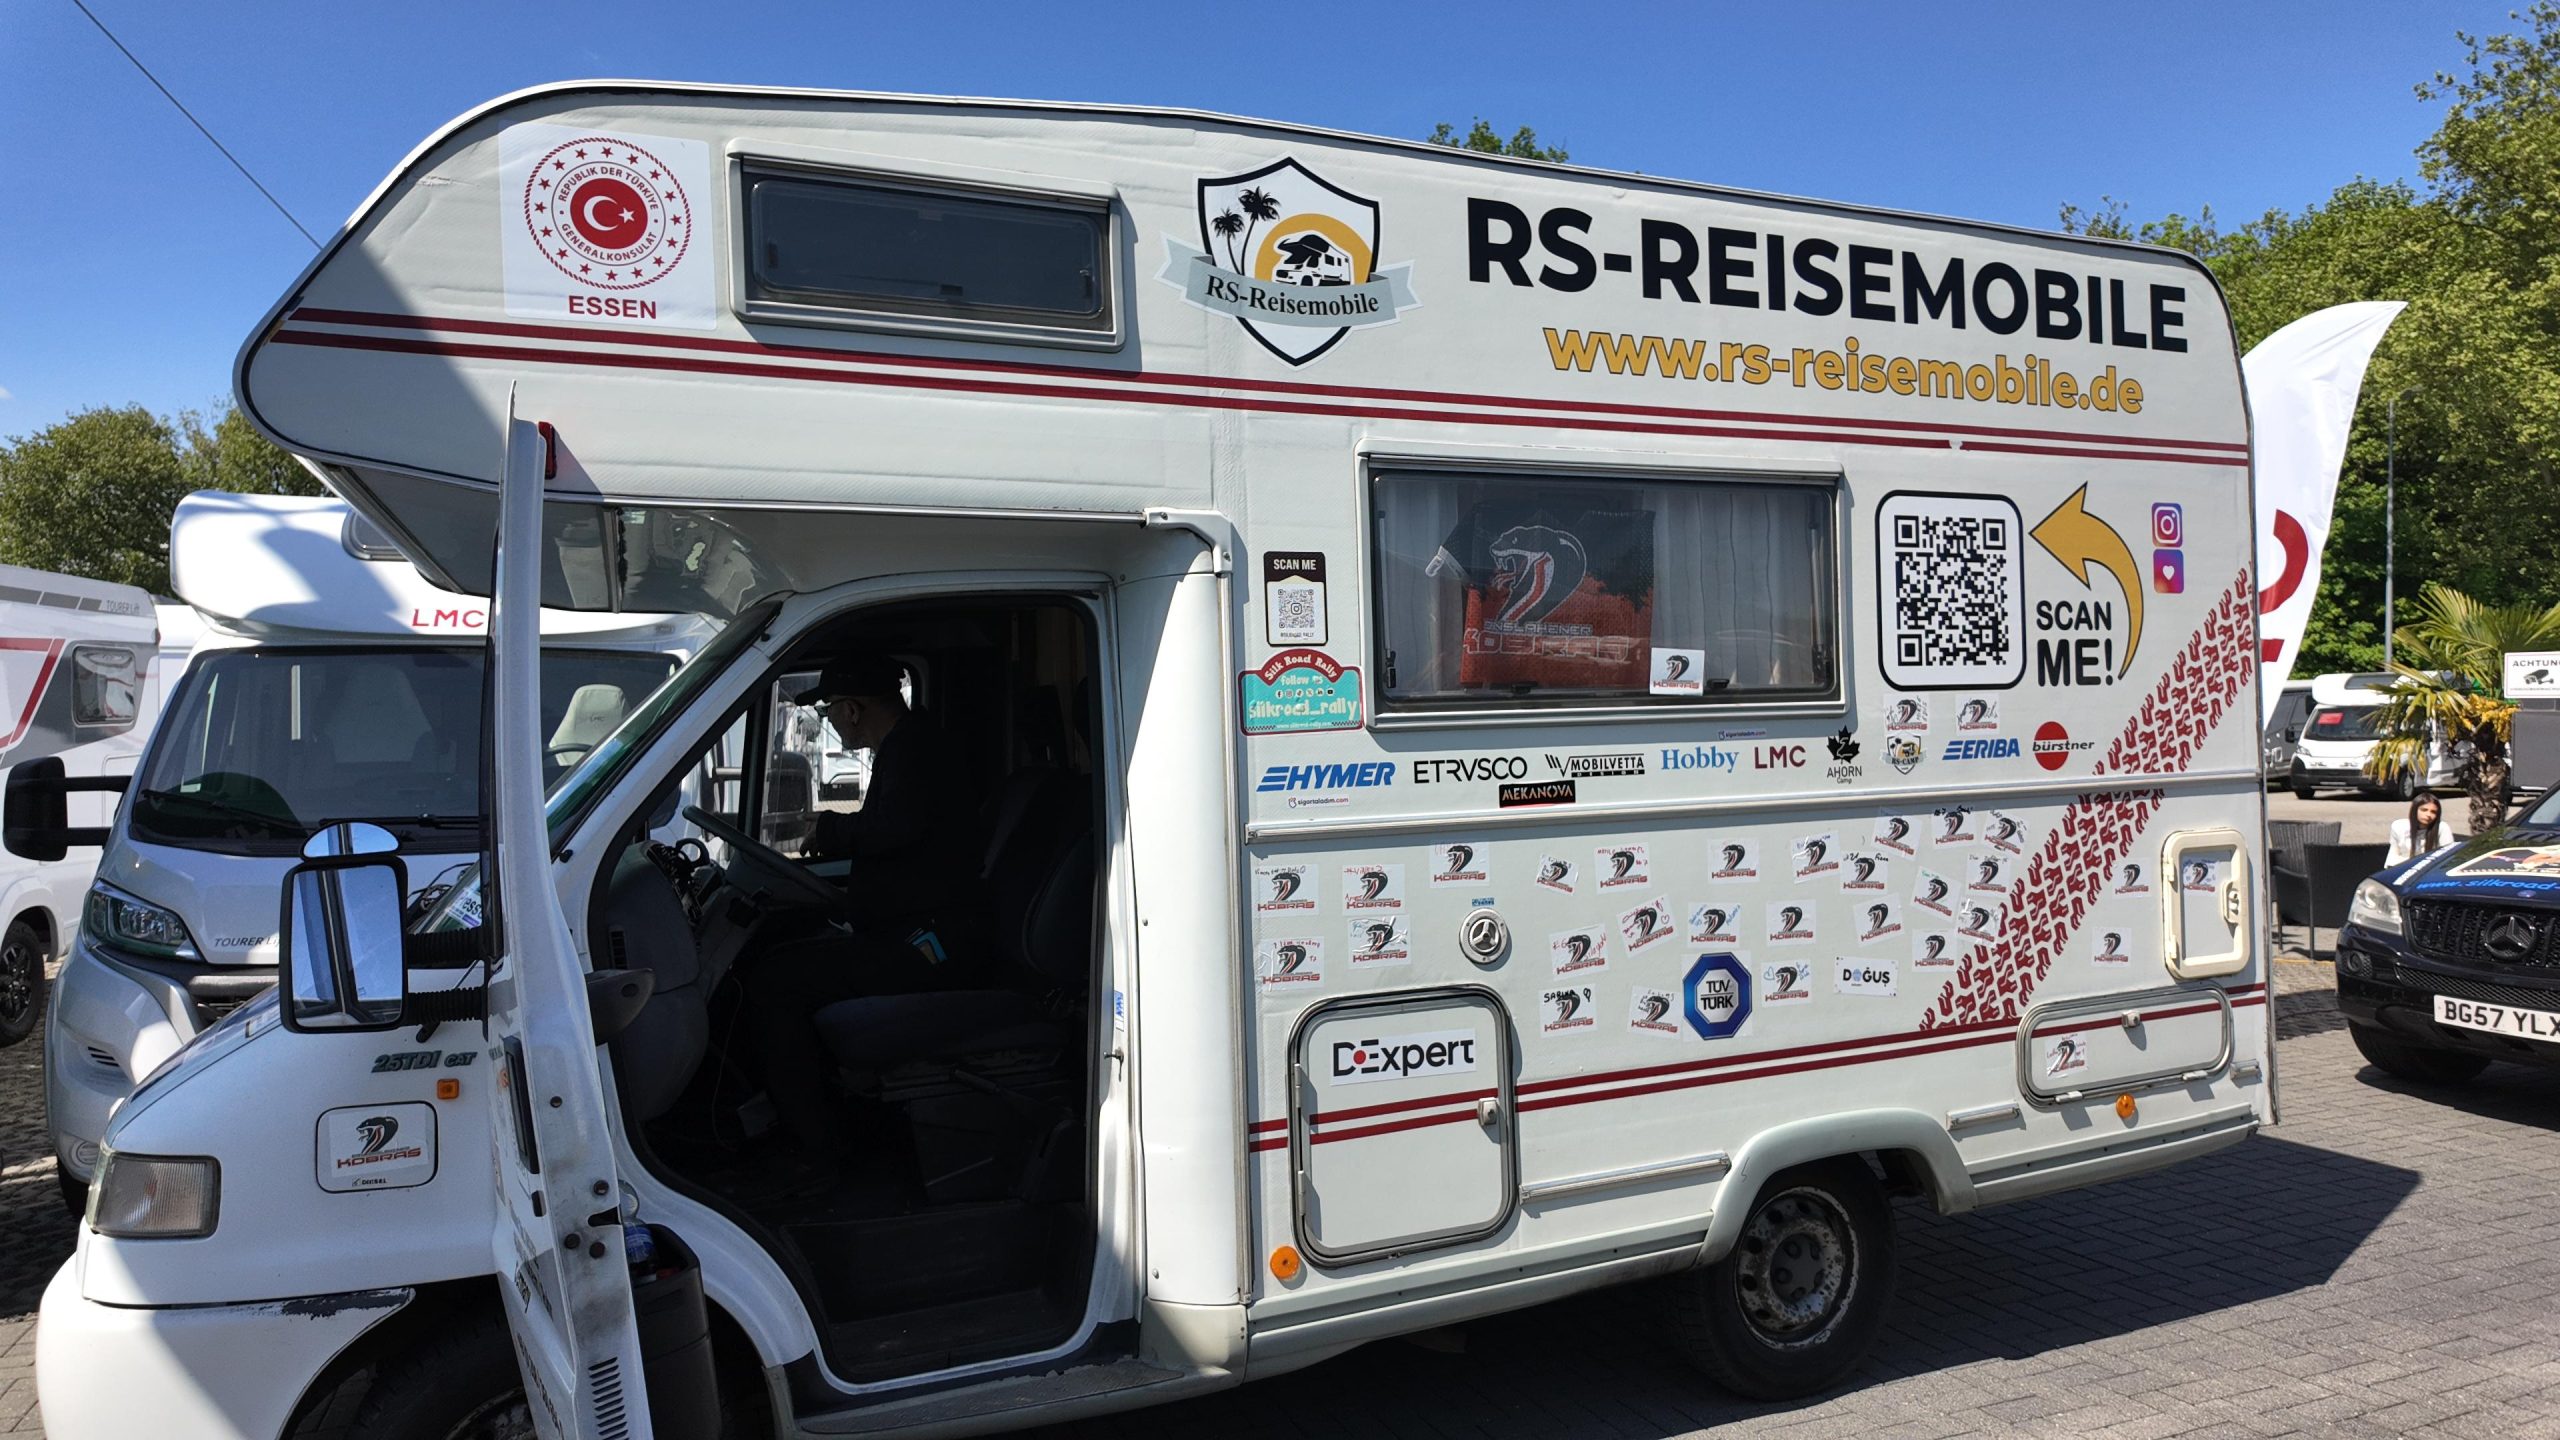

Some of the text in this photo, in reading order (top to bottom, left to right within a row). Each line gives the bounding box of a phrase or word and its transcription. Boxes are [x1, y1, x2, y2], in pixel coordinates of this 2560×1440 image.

[559, 166, 598, 202] REPUBLIK
[600, 166, 622, 178] DER
[562, 223, 657, 262] GENERALKONSULAT
[1466, 196, 2188, 353] RS-REISEMOBILE
[1207, 274, 1379, 316] RS-Reisemobile
[569, 295, 657, 319] ESSEN
[1542, 327, 2145, 414] www.rs-reisemobile.de
[1273, 559, 1317, 571] SCAN ME
[412, 608, 485, 628] LMC
[2036, 600, 2112, 631] SCAN
[1264, 654, 1337, 681] Silk Road Rally
[2037, 638, 2113, 687] ME!
[1754, 745, 1806, 769] LMC
[1961, 738, 2020, 759] ERIBA
[2032, 740, 2095, 752] bürstner
[1571, 757, 1644, 771] MOBILVETTA
[1661, 746, 1739, 773] Hobby
[1285, 762, 1396, 790] HYMER
[1827, 766, 1863, 778] AHORN
[1837, 777, 1853, 785] Camp
[1433, 872, 1486, 882] KOBRAS
[1257, 901, 1315, 912] KOBRAS
[1347, 900, 1401, 910] KOBRAS
[213, 937, 265, 948] TOURER
[1706, 978, 1731, 993] TÜV
[1701, 995, 1734, 1010] TÜRK
[2444, 999, 2504, 1028] BG57
[337, 1147, 421, 1169] KOBRAS
